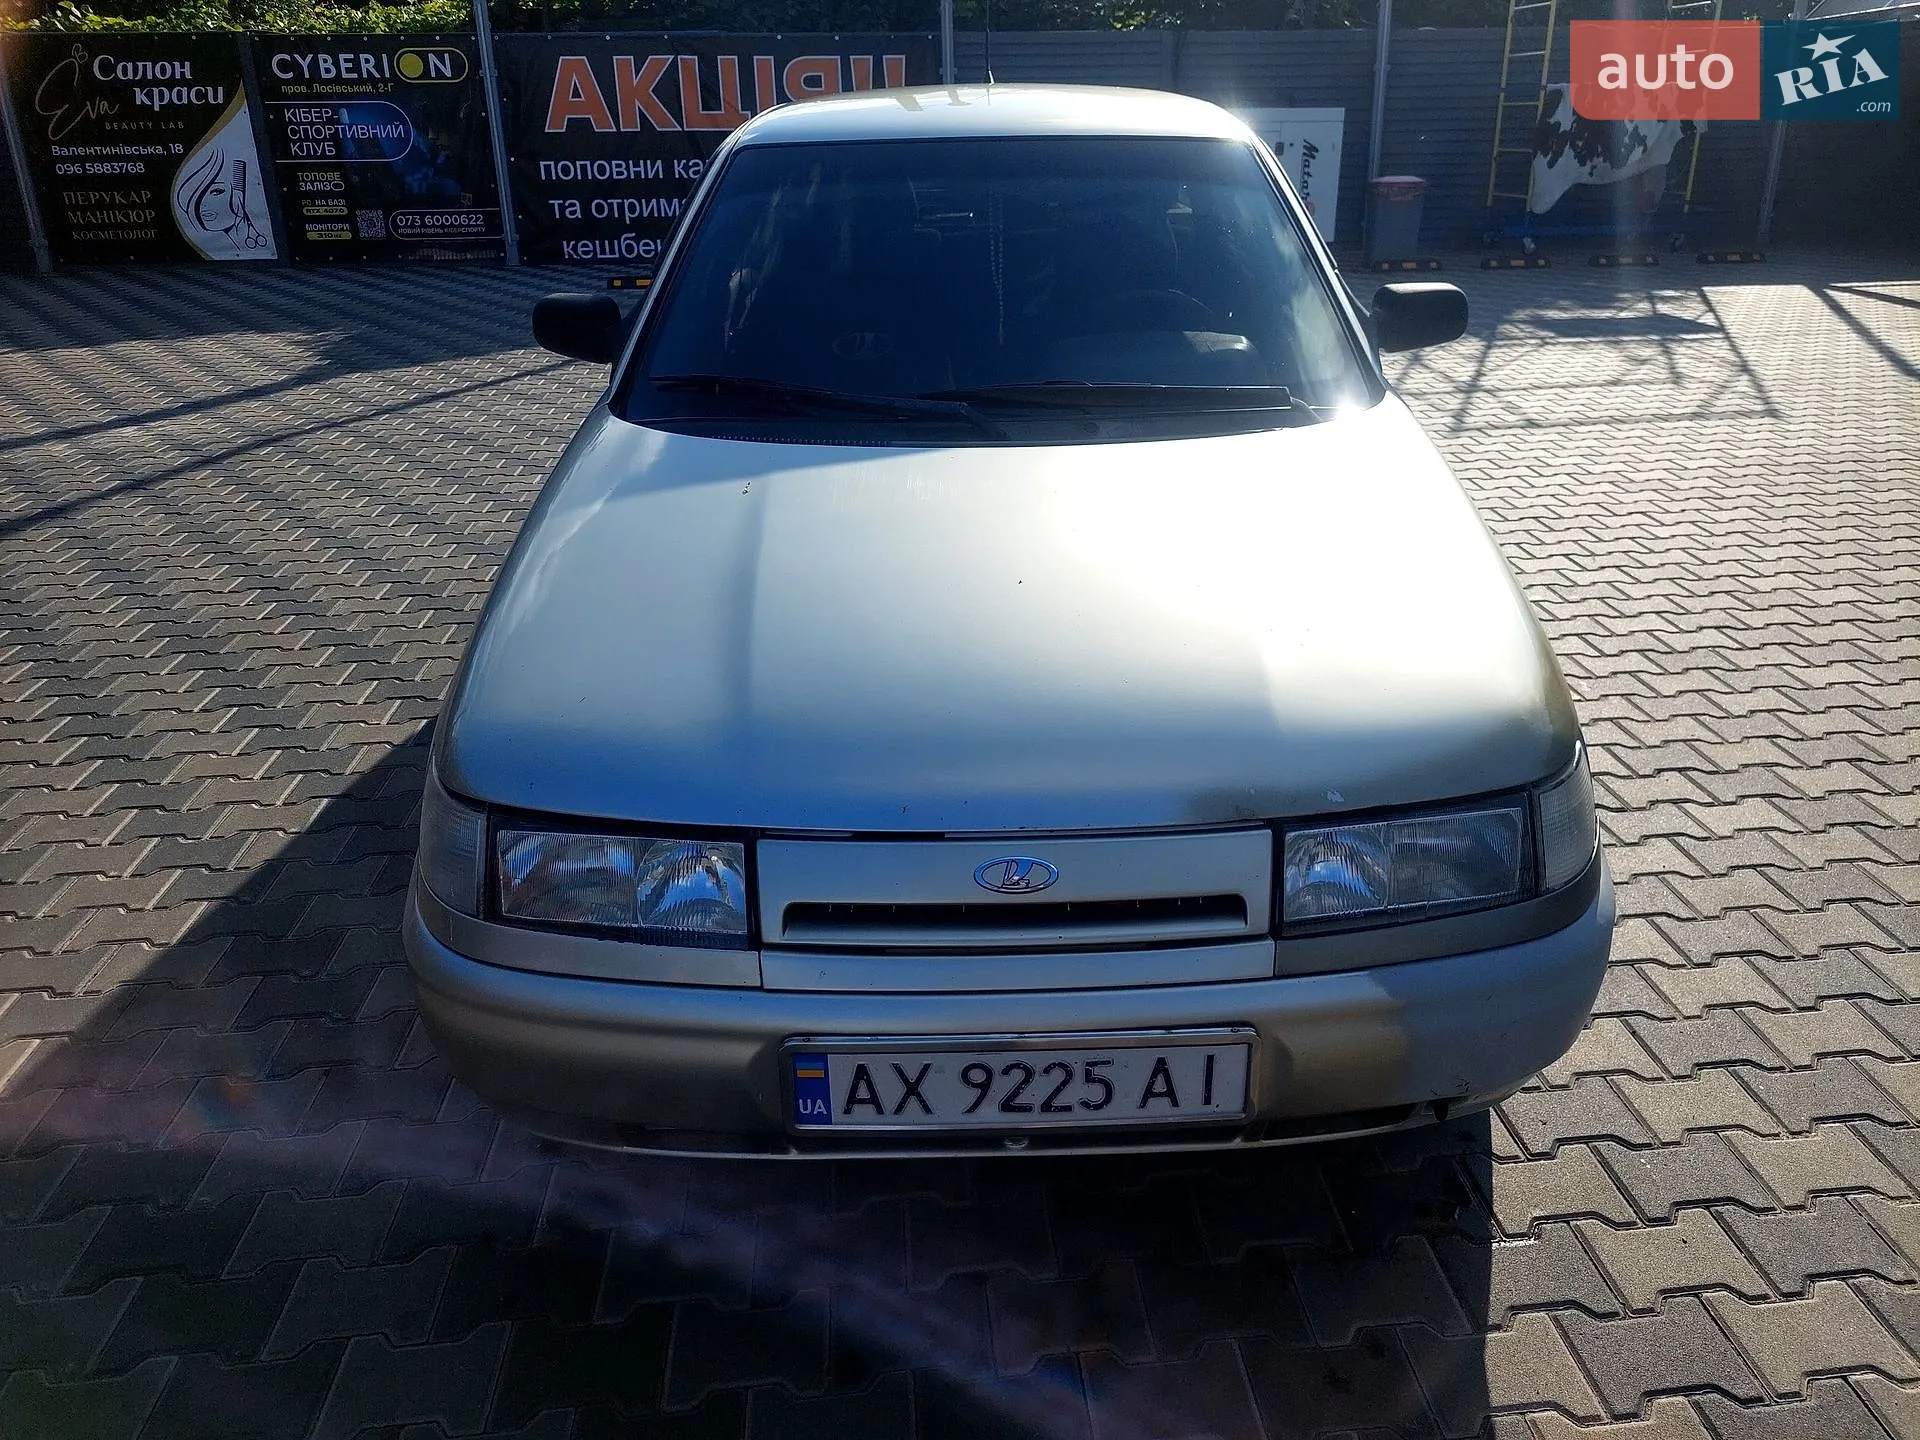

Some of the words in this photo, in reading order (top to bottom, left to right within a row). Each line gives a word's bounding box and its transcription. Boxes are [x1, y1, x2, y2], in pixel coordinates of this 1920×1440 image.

[92, 54, 193, 81] Салон
[271, 52, 453, 79] CYBERION
[281, 85, 311, 94] пров.
[133, 85, 225, 112] краси
[284, 108, 339, 122] КІБЕР-
[105, 121, 153, 130] BEAUTY
[161, 121, 185, 129] LAB
[287, 121, 405, 139] СПОРТИВНИЙ
[51, 144, 167, 157] Валентинівська,
[169, 143, 184, 154] 18
[290, 142, 336, 157] КЛУБ
[55, 164, 83, 175] 096
[85, 162, 146, 174] 5883768
[539, 159, 664, 181] поповни
[673, 158, 709, 179] ка
[297, 172, 341, 181] ТОПОВЕ
[299, 180, 345, 191] ЗАЛІЗО
[63, 190, 153, 205] ПЕРУКАР
[67, 209, 156, 224] МАНІКЮР
[548, 199, 582, 219] та
[591, 198, 687, 225] отрим
[305, 223, 350, 231] МОНІТОРИ
[396, 215, 421, 226] 073
[424, 214, 485, 226] 6000622
[72, 229, 158, 241] КОСМЕТОЛОГ
[842, 1062, 934, 1116] AX
[960, 1058, 1116, 1115] 9225
[1137, 1054, 1216, 1110] AI
[798, 1098, 827, 1116] UA
